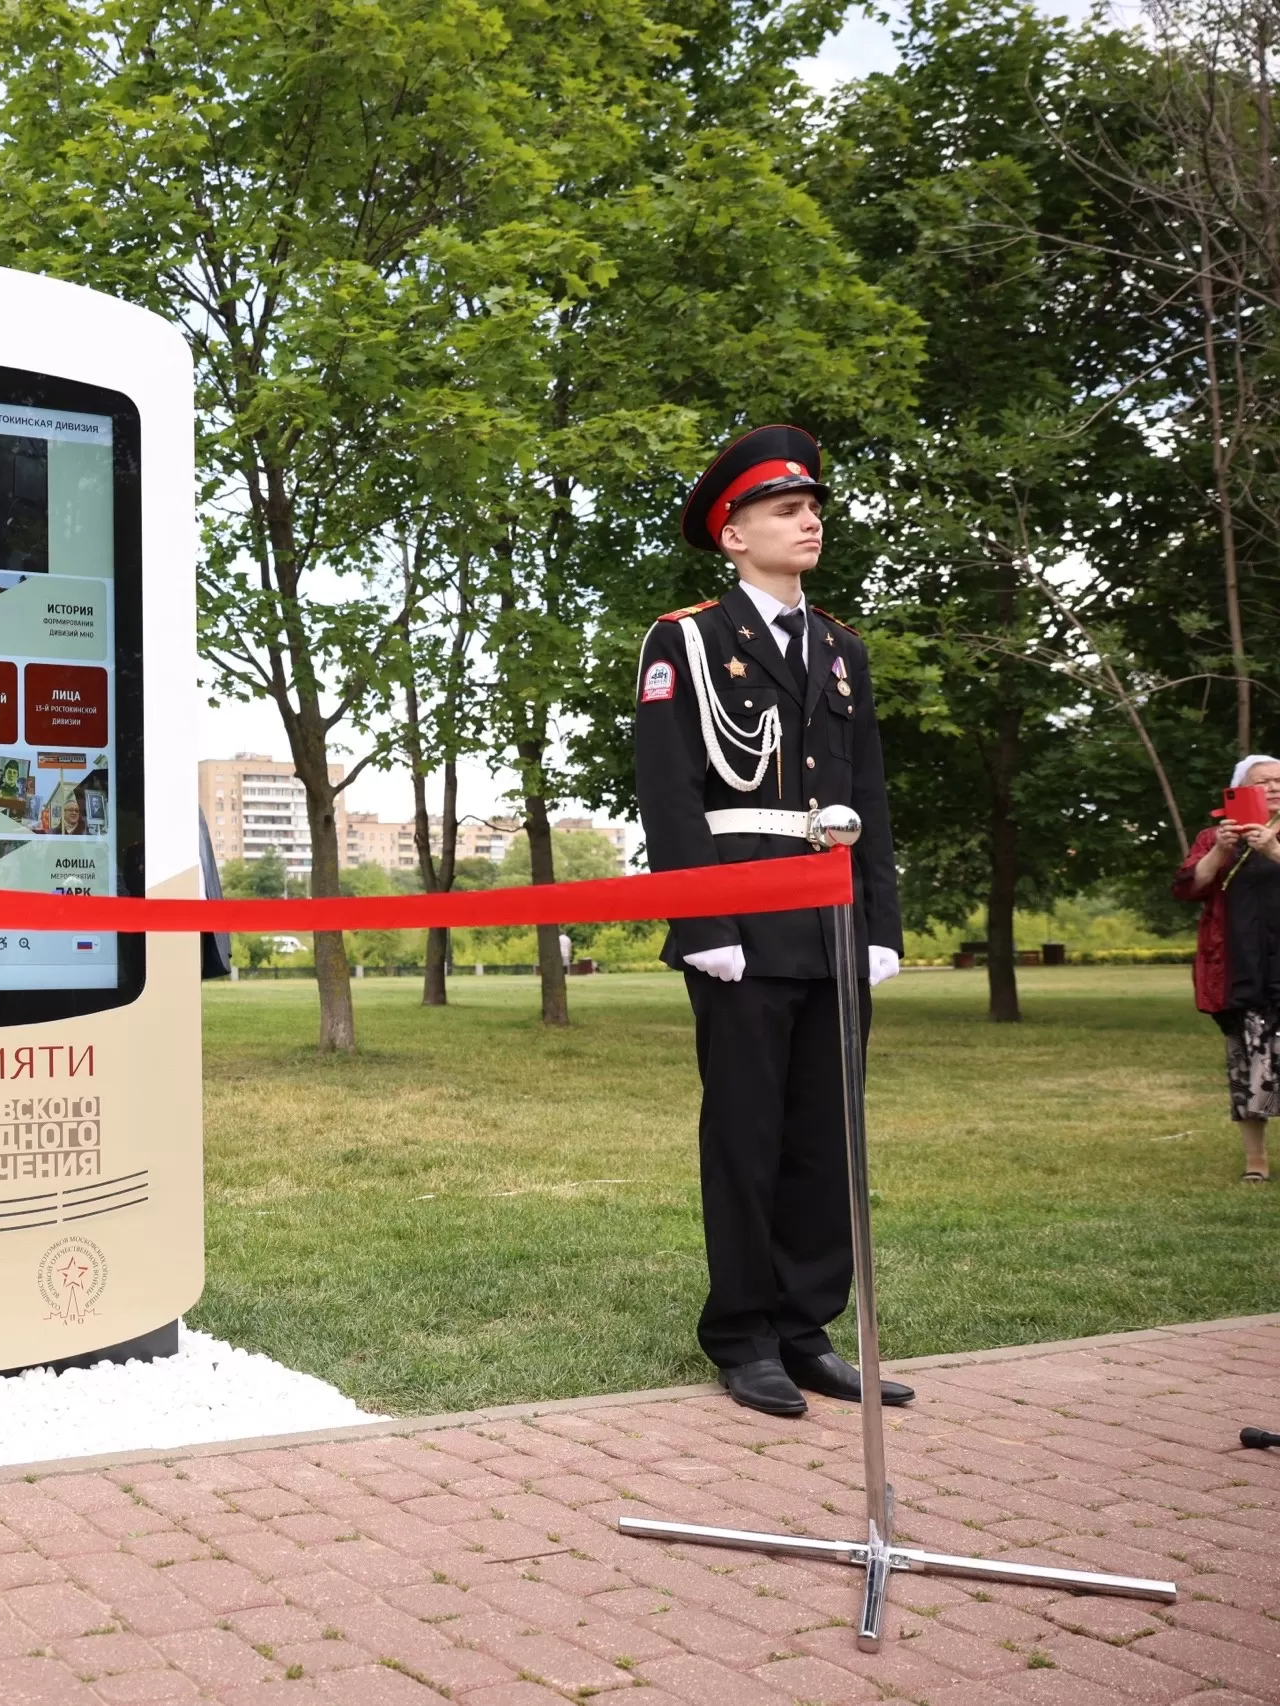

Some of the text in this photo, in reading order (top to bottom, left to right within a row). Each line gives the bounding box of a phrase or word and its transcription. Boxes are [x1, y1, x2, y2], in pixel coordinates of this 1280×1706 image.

[55, 420, 99, 433] ДИВИЗИЯ
[47, 603, 93, 616] ИСТОРИЯ
[42, 617, 94, 627] ФОРМИРОВАНИЯ
[52, 689, 81, 702] ЛИЦА
[51, 705, 97, 714] РОСТОКИНСКОЙ
[52, 718, 81, 726] ДИВИЗИИ
[55, 858, 96, 869] АФИША
